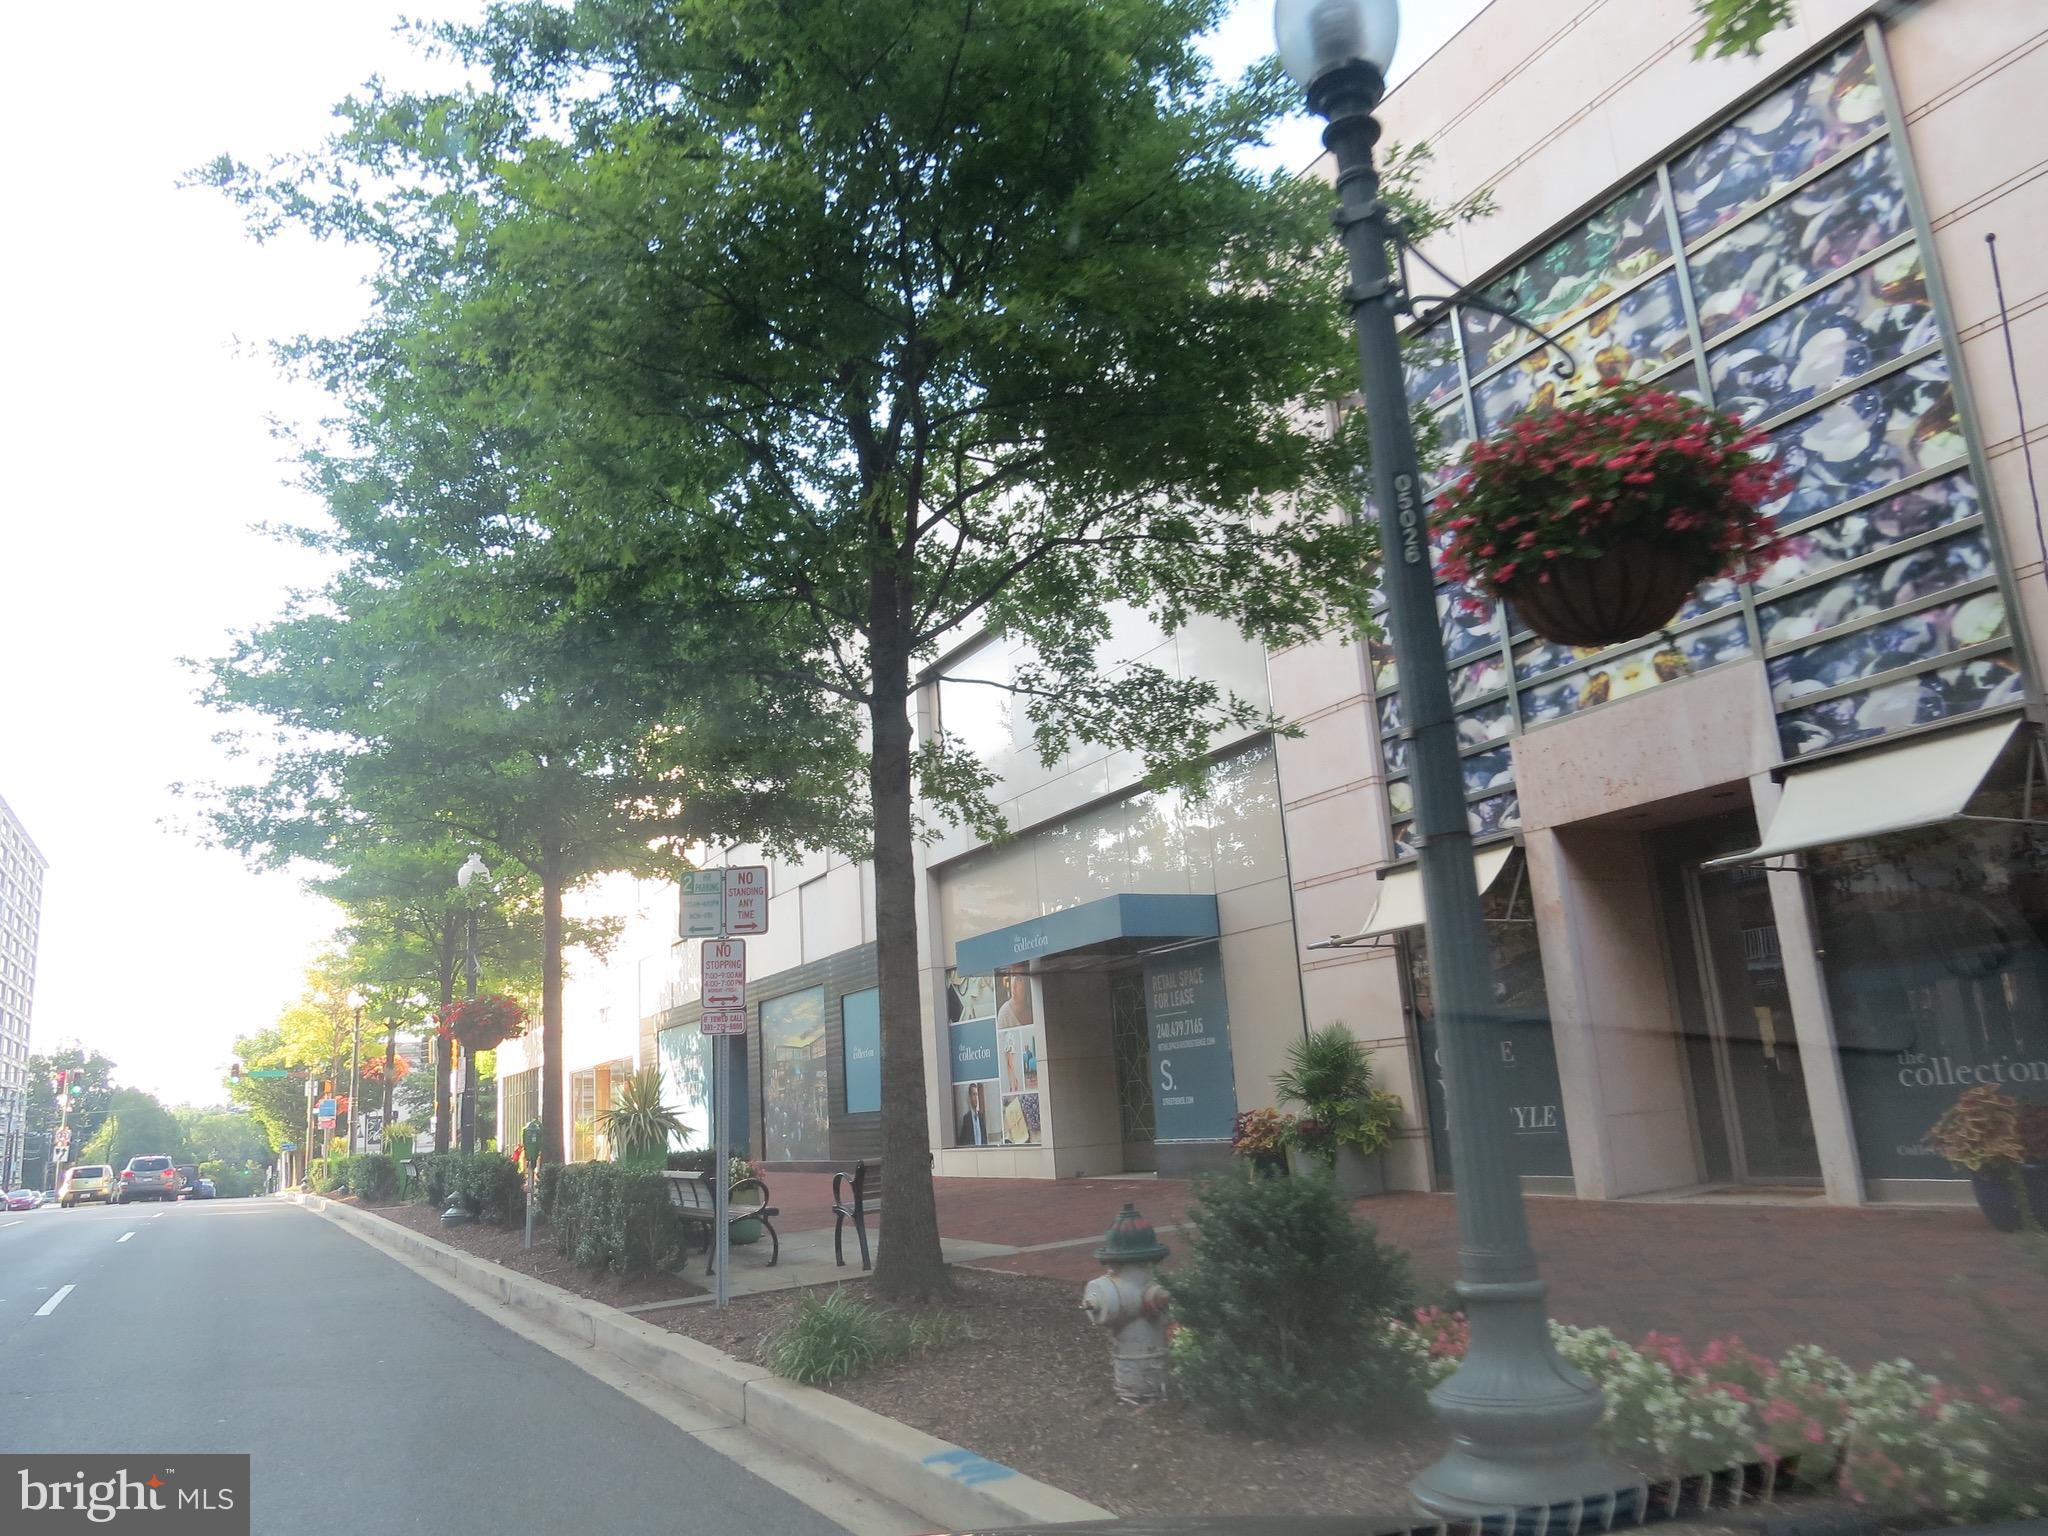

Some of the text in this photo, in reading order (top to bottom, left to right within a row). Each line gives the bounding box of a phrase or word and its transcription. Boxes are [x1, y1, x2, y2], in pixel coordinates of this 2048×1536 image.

[1394, 474, 1421, 563] 05026
[682, 875, 693, 892] 2
[738, 872, 753, 885] NO
[728, 886, 764, 897] STANDING
[738, 899, 754, 908] ANY
[737, 910, 755, 919] TIME
[715, 944, 731, 957] NO
[705, 959, 742, 970] STOPPING
[1152, 967, 1204, 992] RETAIL SPACE
[1153, 987, 1195, 1009] FOR LEASE
[730, 1013, 743, 1022] CALL
[1896, 1050, 1927, 1065] the
